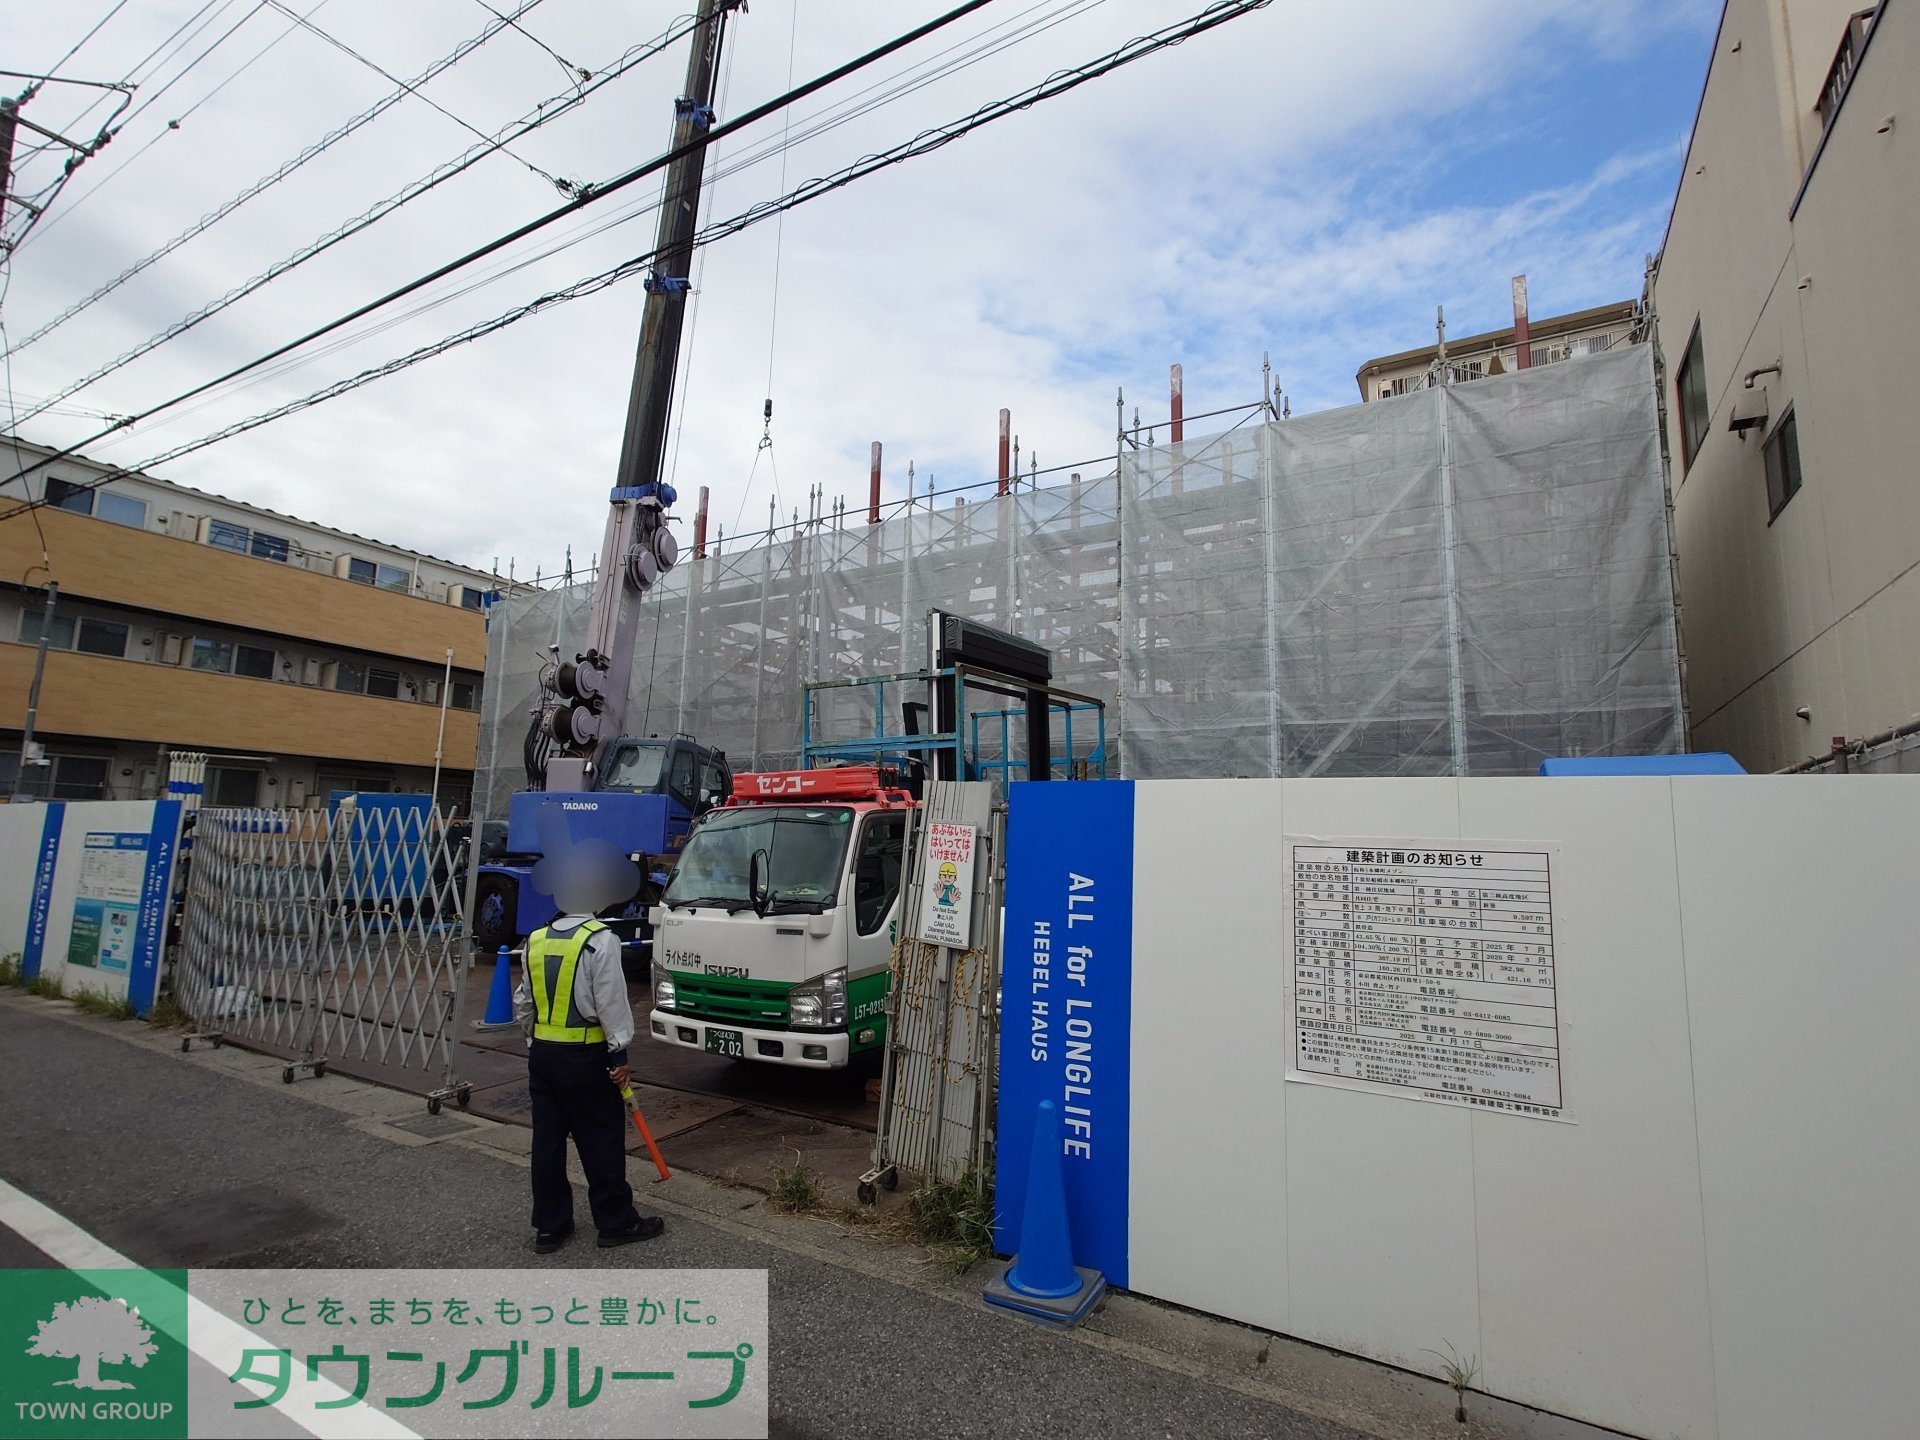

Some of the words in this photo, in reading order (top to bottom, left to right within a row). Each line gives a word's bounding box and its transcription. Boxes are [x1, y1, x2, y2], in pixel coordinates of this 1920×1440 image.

[756, 776, 816, 794] センコー
[562, 802, 598, 810] TADANO
[930, 836, 970, 849] はいっては
[932, 824, 972, 838] あぶないから
[42, 838, 56, 894] HEBEL
[158, 842, 168, 867] ALL
[1346, 850, 1484, 866] 建築計画のお知らせ
[1067, 872, 1095, 930] ALL
[34, 899, 46, 945] HAUS
[144, 899, 160, 968] LONGLIFE
[666, 949, 701, 968] ライト点灯中
[1032, 920, 1050, 994] HEBEL
[1066, 946, 1093, 987] for
[704, 964, 749, 978] ISUZU
[1031, 1001, 1049, 1062] HAUS
[1064, 999, 1092, 1160] LONGLIFE
[1462, 1096, 1560, 1118] 千葉県建築士事務所協会
